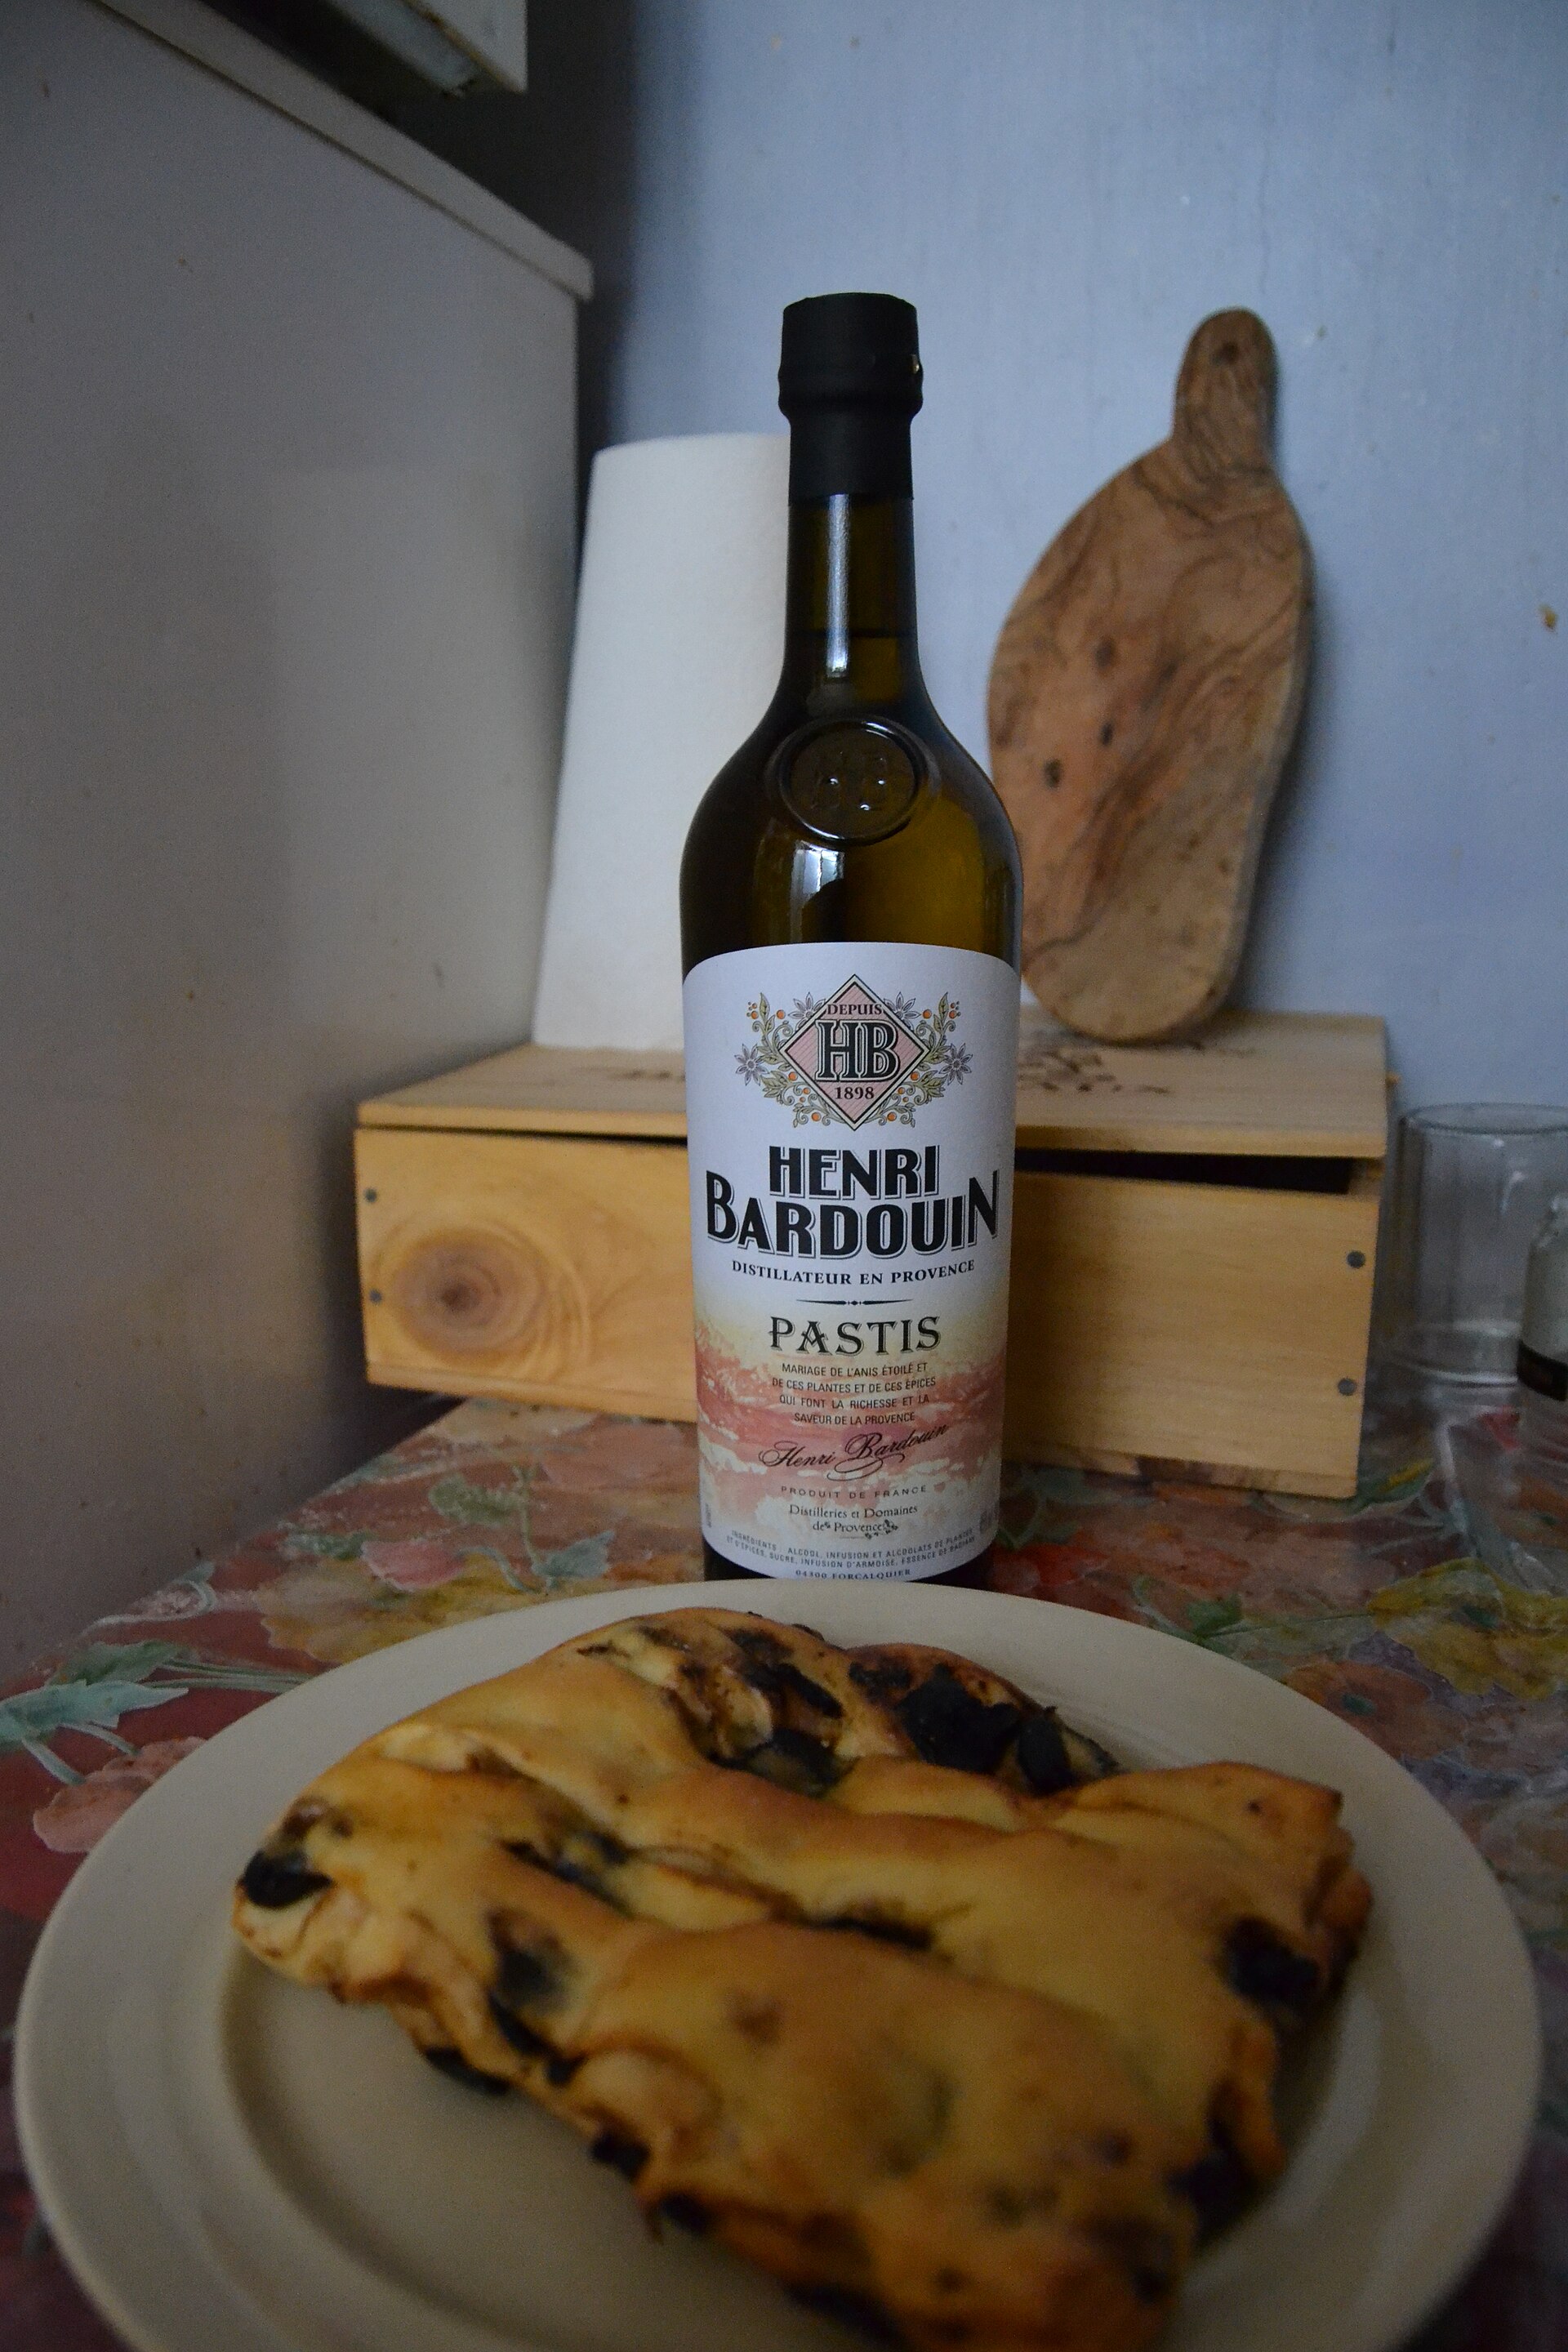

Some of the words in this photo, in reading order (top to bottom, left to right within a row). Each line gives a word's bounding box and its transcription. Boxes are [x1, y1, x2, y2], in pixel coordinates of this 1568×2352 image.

[826, 1003, 883, 1016] DEPUIS
[815, 1018, 901, 1082] HB
[835, 1087, 875, 1100] 1898
[768, 1145, 941, 1200] HENRI
[706, 1169, 1000, 1259] BARDOUIN
[732, 1260, 852, 1285] DISTILLATEUR
[860, 1272, 884, 1285] EN
[891, 1259, 975, 1284] PROVENCE
[769, 1316, 942, 1356] PASTIS
[782, 1363, 826, 1376] MARIAGE
[830, 1367, 843, 1377] DE
[847, 1367, 879, 1377] L'ANIS
[882, 1362, 914, 1376] ÉTOILÉ
[916, 1362, 928, 1372] ET
[772, 1377, 784, 1388] DE
[786, 1379, 804, 1391] CES
[807, 1382, 851, 1393] PLANTES
[854, 1383, 866, 1393] ET
[868, 1383, 881, 1393] DE
[884, 1382, 902, 1392] CES
[905, 1377, 937, 1390] ÉPICES
[779, 1394, 795, 1405] QUI
[801, 1397, 826, 1408] FONT
[831, 1400, 844, 1409] LA
[850, 1398, 898, 1409] RICHESSE
[902, 1396, 914, 1405] ET
[918, 1394, 930, 1404] LA
[794, 1412, 832, 1424] SAVEUR
[835, 1415, 847, 1425] DE
[850, 1415, 862, 1425] LA
[865, 1412, 915, 1424] PROVENCE
[758, 1441, 837, 1467] Henri
[831, 1424, 950, 1473] Bardouin
[781, 1485, 841, 1499] PRODUIT
[849, 1491, 866, 1499] DE
[874, 1485, 927, 1499] FRANCE
[789, 1503, 848, 1519] Distilleries
[851, 1510, 860, 1519] et
[864, 1504, 918, 1519] Domaines
[834, 1522, 884, 1533] Provence
[872, 1551, 882, 1559] ET
[801, 1558, 843, 1568] INFUSION
[831, 1568, 911, 1580] FORCALQUIER
